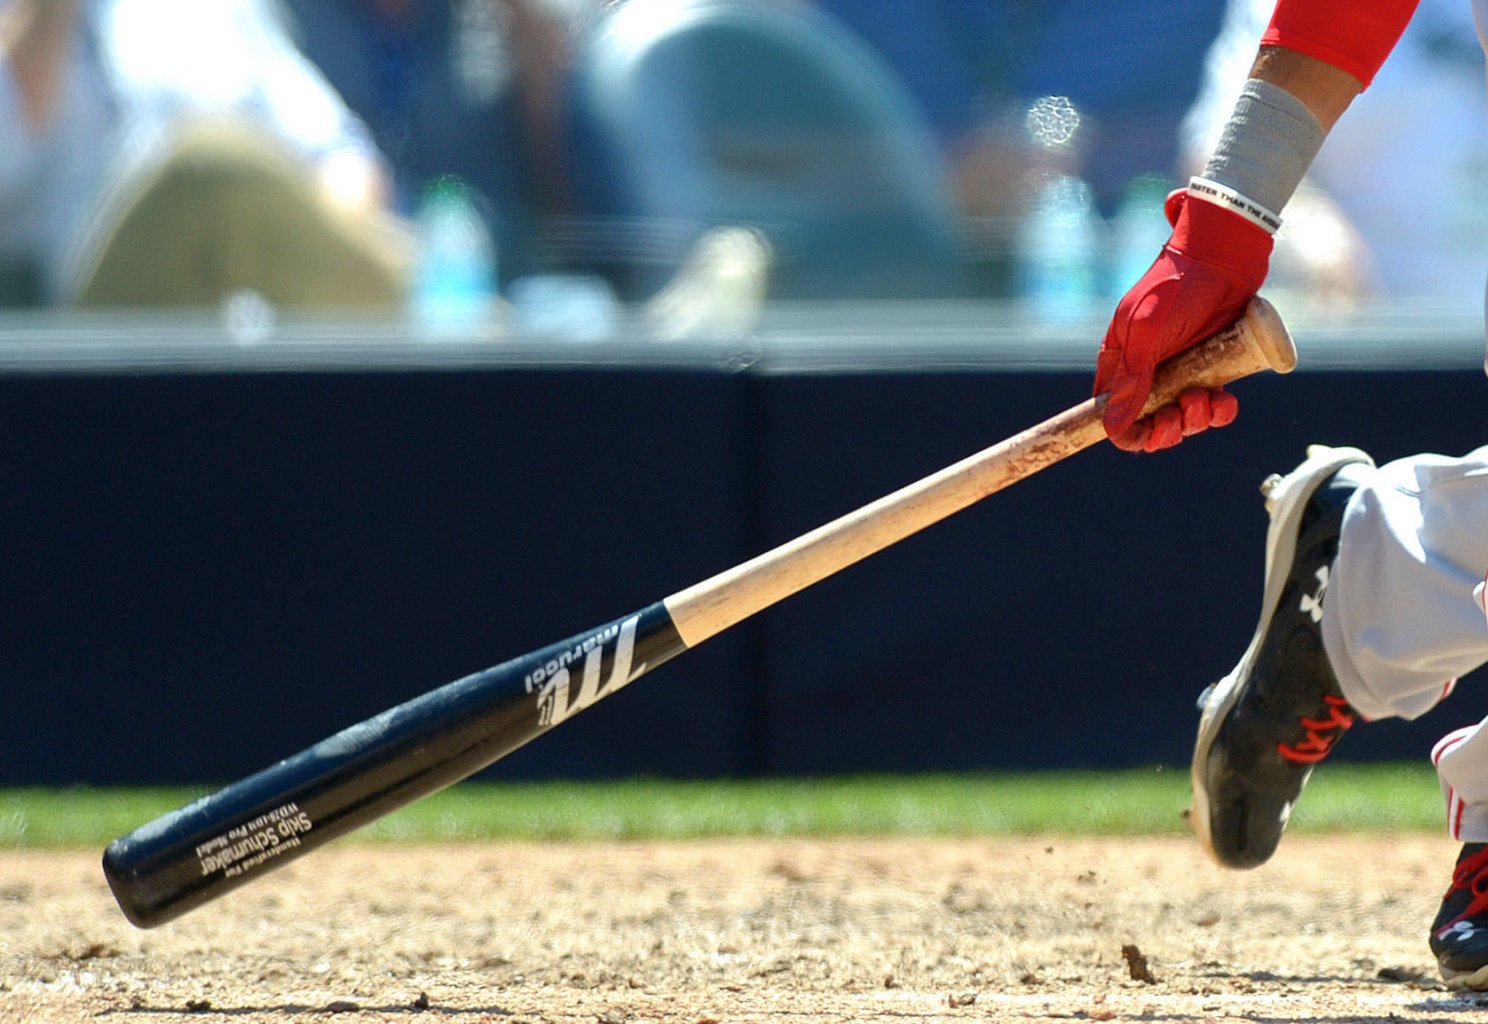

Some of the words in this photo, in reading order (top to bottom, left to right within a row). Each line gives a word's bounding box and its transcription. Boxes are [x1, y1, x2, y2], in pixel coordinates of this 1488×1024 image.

[1221, 192, 1245, 208] THAN
[1247, 205, 1261, 218] THE
[525, 624, 619, 694] marucci
[278, 812, 312, 837] Skip
[201, 827, 280, 877] Schumaker
